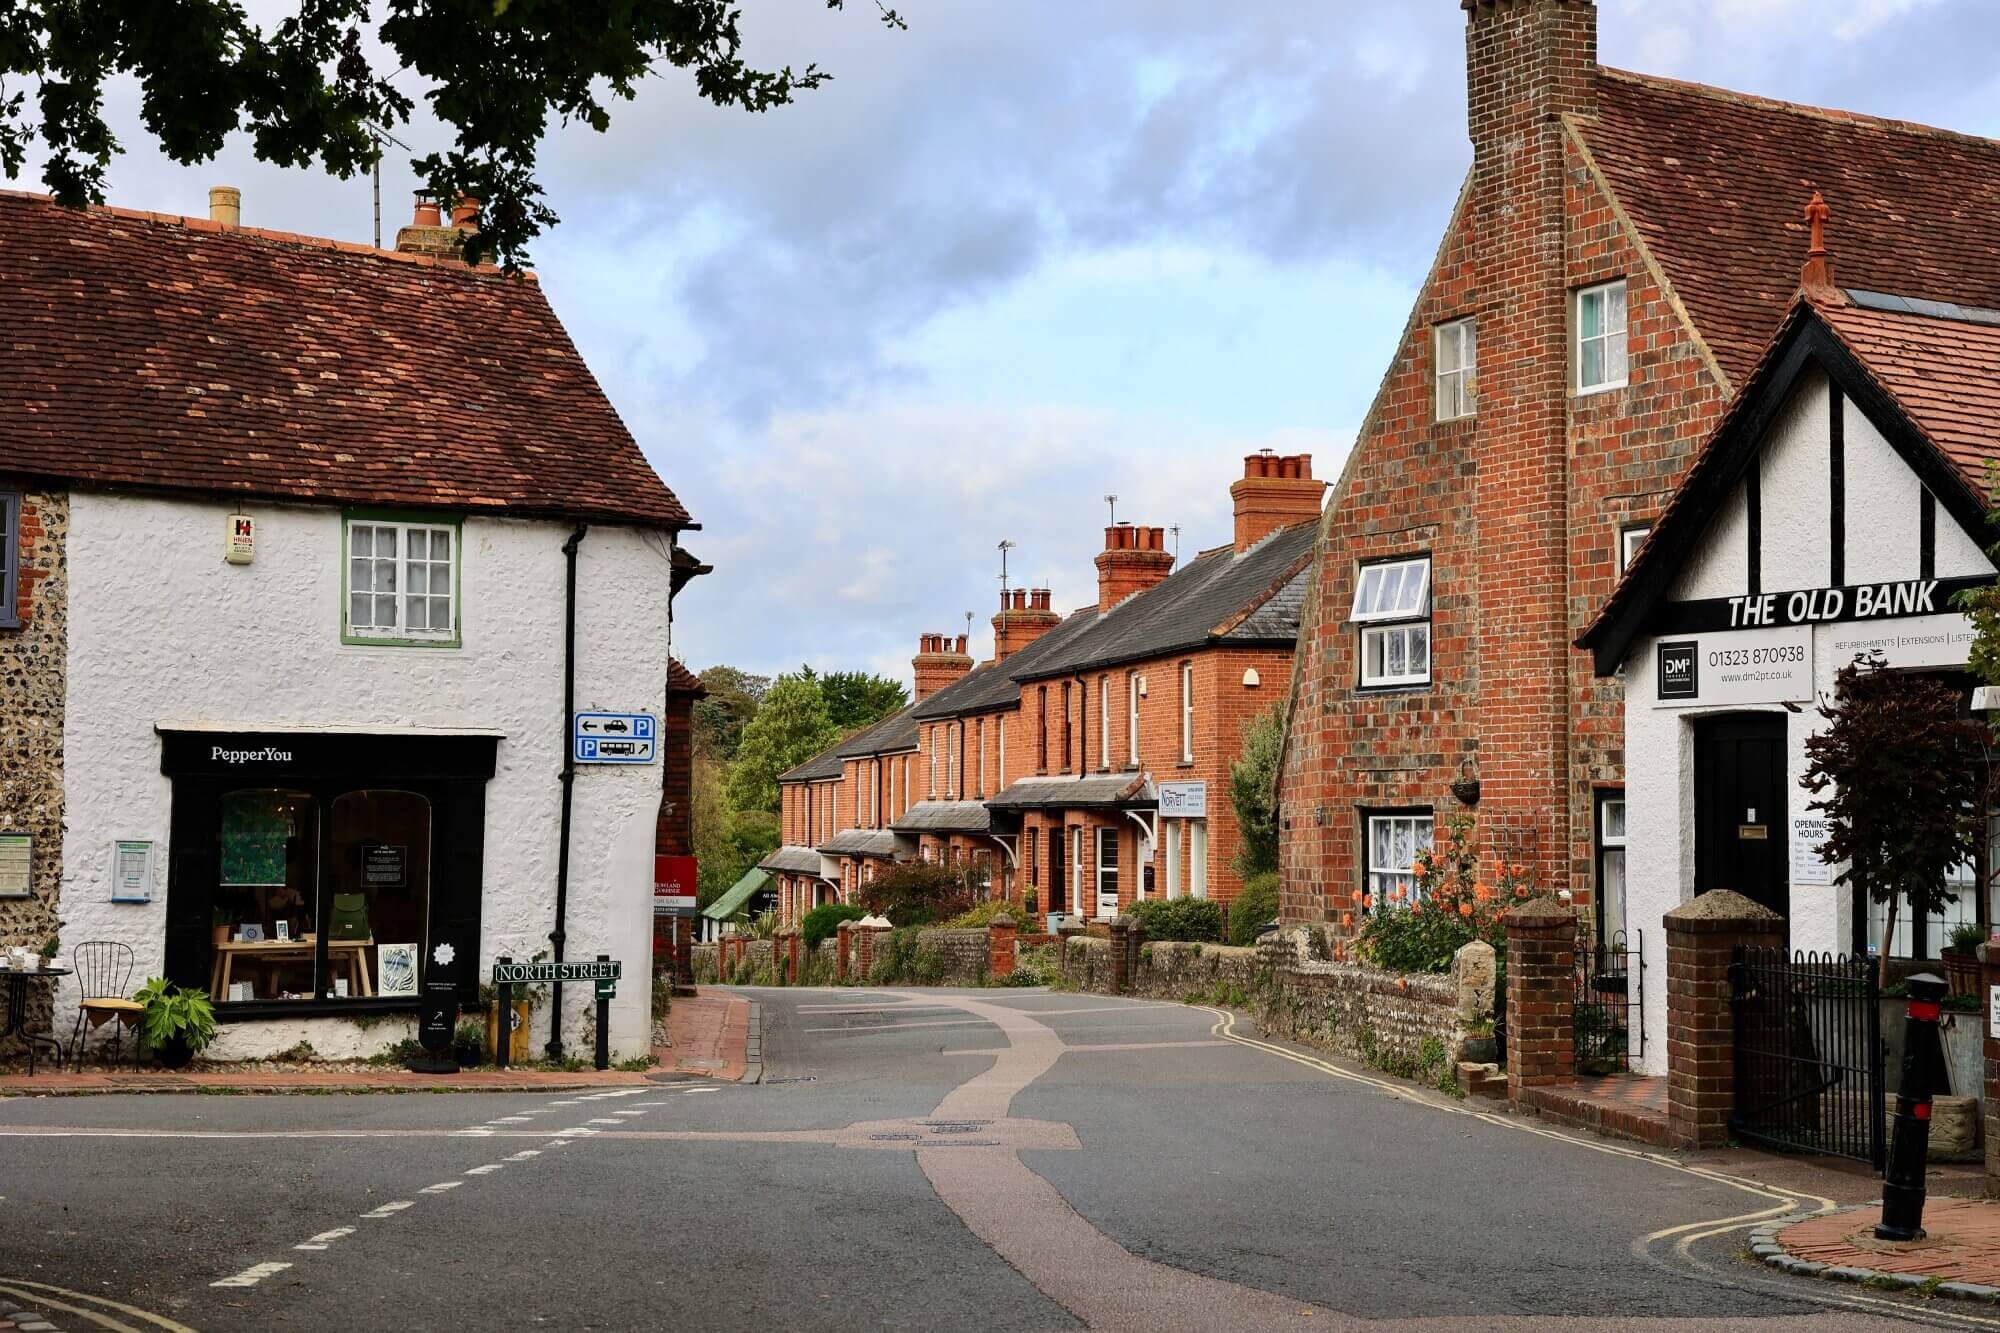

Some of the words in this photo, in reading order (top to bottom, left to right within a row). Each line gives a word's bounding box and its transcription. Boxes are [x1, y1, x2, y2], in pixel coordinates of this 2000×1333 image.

[1728, 594, 1777, 627] THE
[1787, 589, 1844, 623] OLD
[1855, 580, 1939, 618] BANK
[1835, 638, 1896, 649] REFURBISHMENTS
[1901, 635, 1945, 646] EXTENSIONS
[1709, 650, 1749, 667] 01323
[1753, 645, 1805, 664] 870938
[1721, 670, 1793, 683] www.dm2pt.co.uk
[211, 746, 293, 764] PepperYou
[1794, 820, 1828, 829] OPENING
[1798, 829, 1824, 839] HOURS
[500, 965, 556, 981] NORTH
[561, 963, 617, 979] STREET
